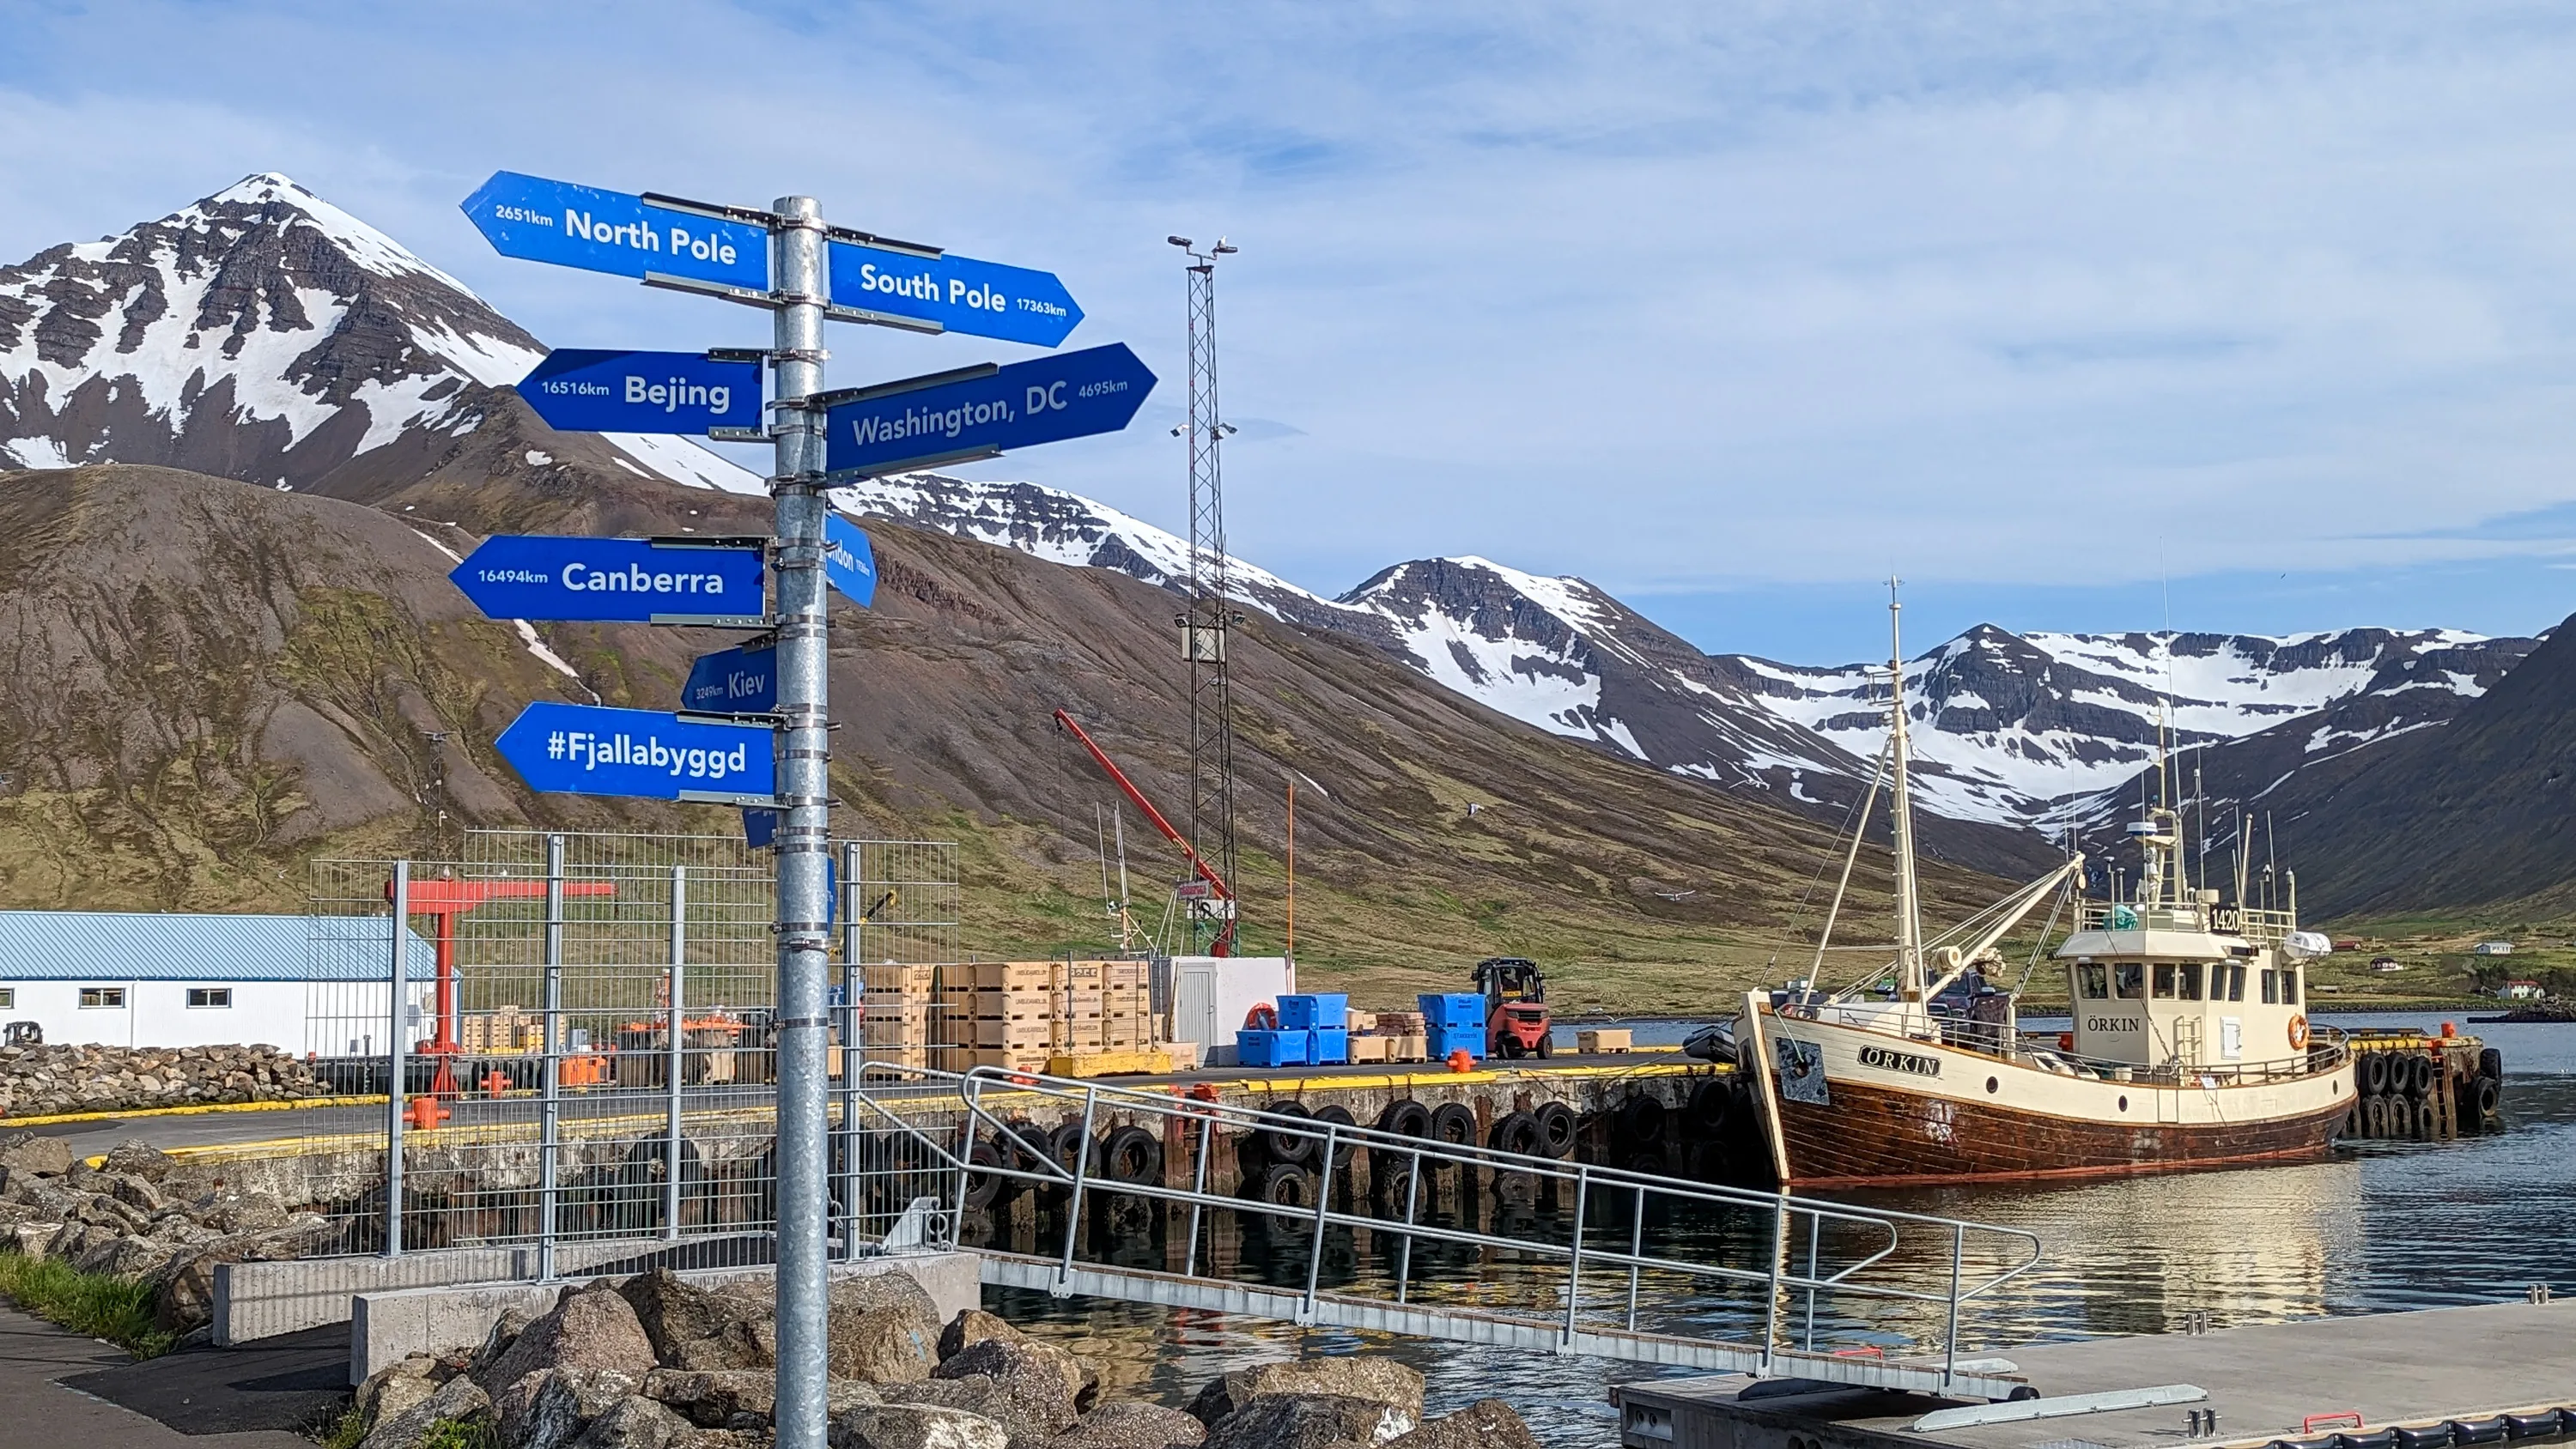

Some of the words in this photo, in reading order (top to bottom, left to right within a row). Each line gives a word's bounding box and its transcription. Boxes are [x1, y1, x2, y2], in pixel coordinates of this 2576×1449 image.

[495, 204, 553, 227] 2651km
[566, 208, 659, 252] North
[671, 227, 737, 265] Pole
[860, 264, 939, 302] South
[949, 278, 1006, 312] Pole
[1017, 297, 1066, 318] 17363km
[541, 381, 610, 396] 16516km
[625, 375, 730, 415] Bejing
[852, 399, 1016, 446] Washington,
[1026, 380, 1067, 415] DC
[1078, 379, 1128, 398] 4695km
[477, 569, 549, 584] 16494km
[562, 562, 723, 594] Canberra
[696, 684, 724, 700] 3249km
[728, 670, 765, 699] Kiev
[547, 731, 745, 779] #Fjallabyggd
[2211, 908, 2240, 932] 1420
[2087, 1015, 2140, 1032] ÖRKIN
[1866, 1047, 1936, 1075] ÖRKIN
